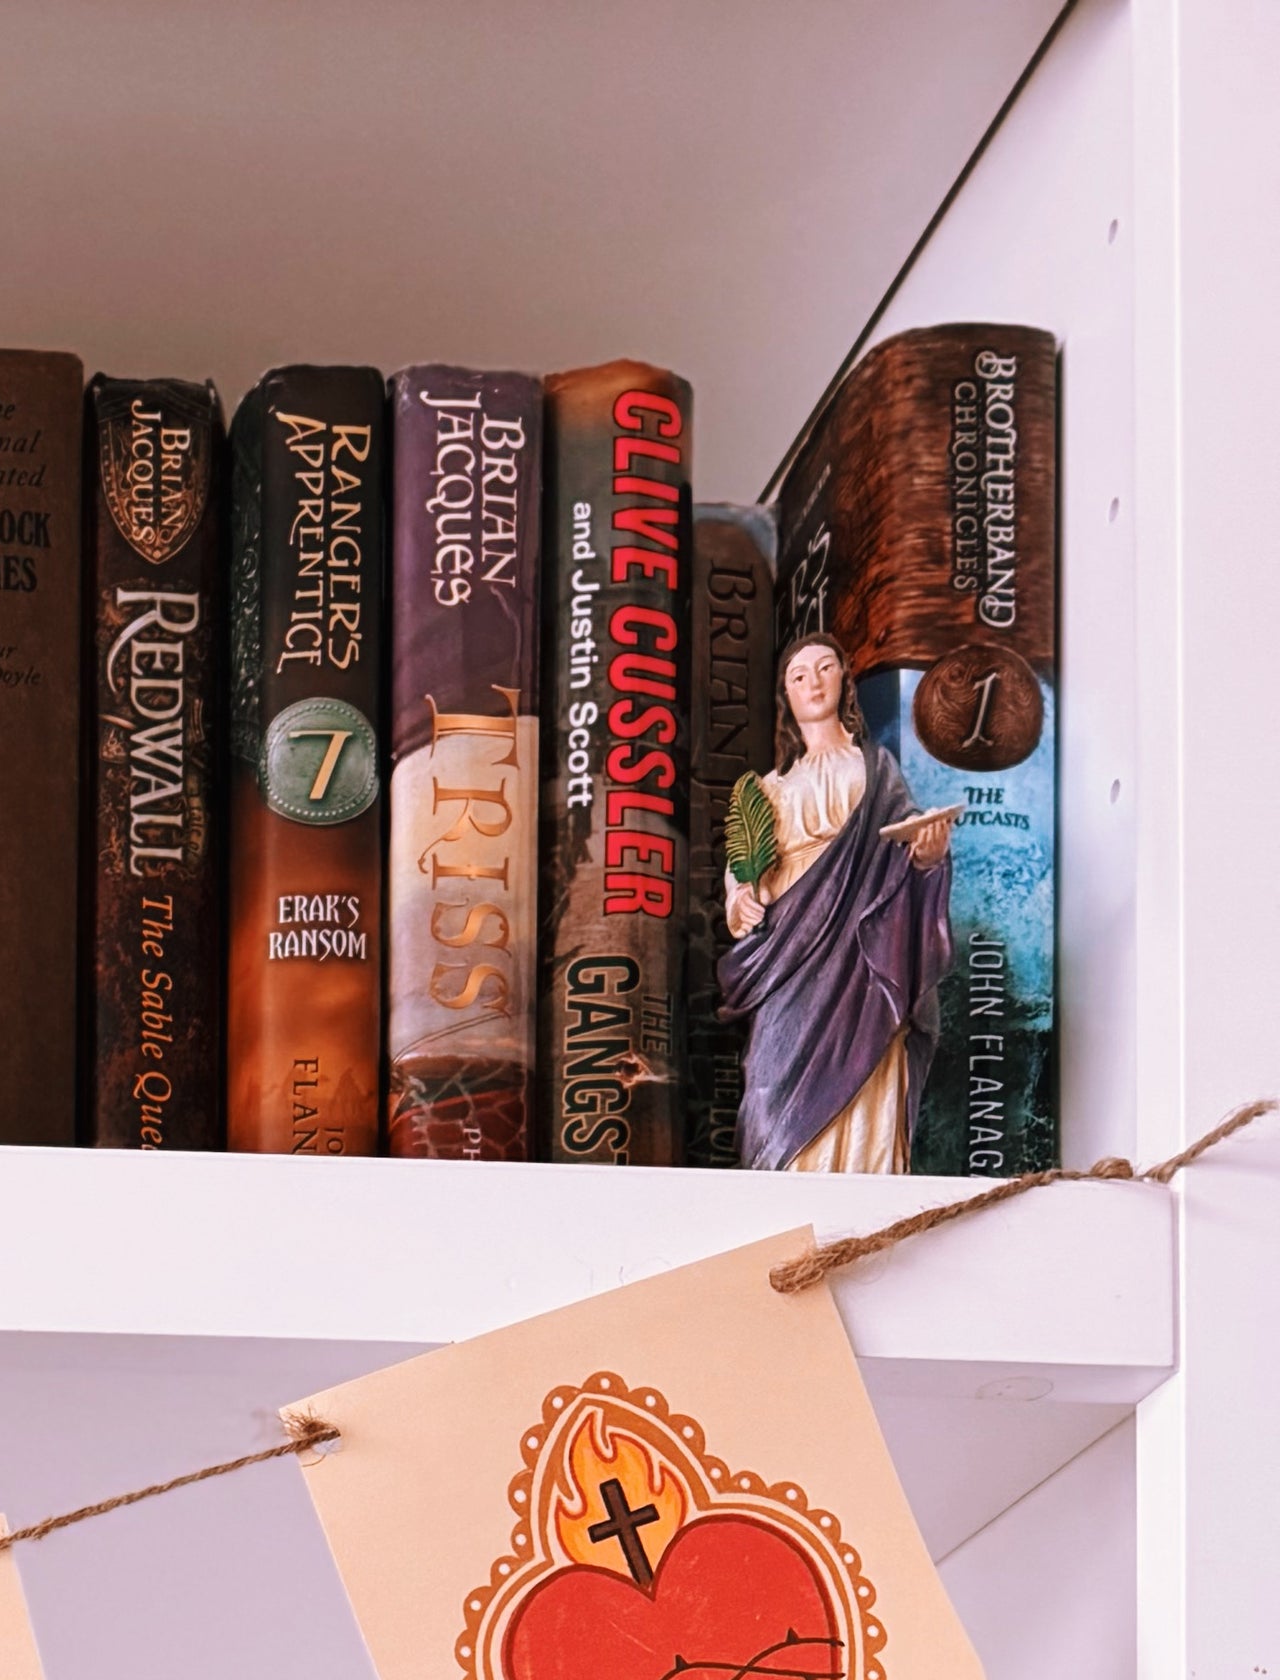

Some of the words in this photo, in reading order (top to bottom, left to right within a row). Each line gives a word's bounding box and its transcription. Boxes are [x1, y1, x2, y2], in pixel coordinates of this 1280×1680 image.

[127, 399, 163, 543] JACQUES
[160, 427, 192, 532] BRIAN
[480, 412, 526, 588] BRIAN
[610, 388, 683, 591] CLIVE
[952, 381, 978, 590] CHRONICLES
[975, 350, 1018, 629] BROTHERBAND
[275, 411, 327, 674] APPRENTICE
[327, 424, 371, 670] RANGER'S
[572, 501, 596, 561] and
[570, 568, 600, 690] Justin
[706, 559, 757, 762] BRIAN
[107, 587, 200, 878] REDWALL
[288, 730, 354, 800] 7
[567, 701, 599, 809] Scott
[603, 603, 679, 920] CUSSLER
[952, 810, 1030, 831] UTCASTS
[963, 786, 1005, 806] THE
[417, 684, 522, 1020] TRISS
[141, 895, 174, 958] The
[268, 929, 367, 962] RANSOM
[278, 894, 360, 929] ERAK'S
[141, 969, 173, 1060] Sable
[640, 991, 675, 1057] THE
[968, 932, 1005, 1017] JOHN
[292, 1055, 319, 1154] FLAN
[561, 953, 641, 1167] GANGS
[713, 1050, 740, 1100] THE
[968, 1035, 1005, 1171] FLANAG
[324, 1127, 345, 1154] JO
